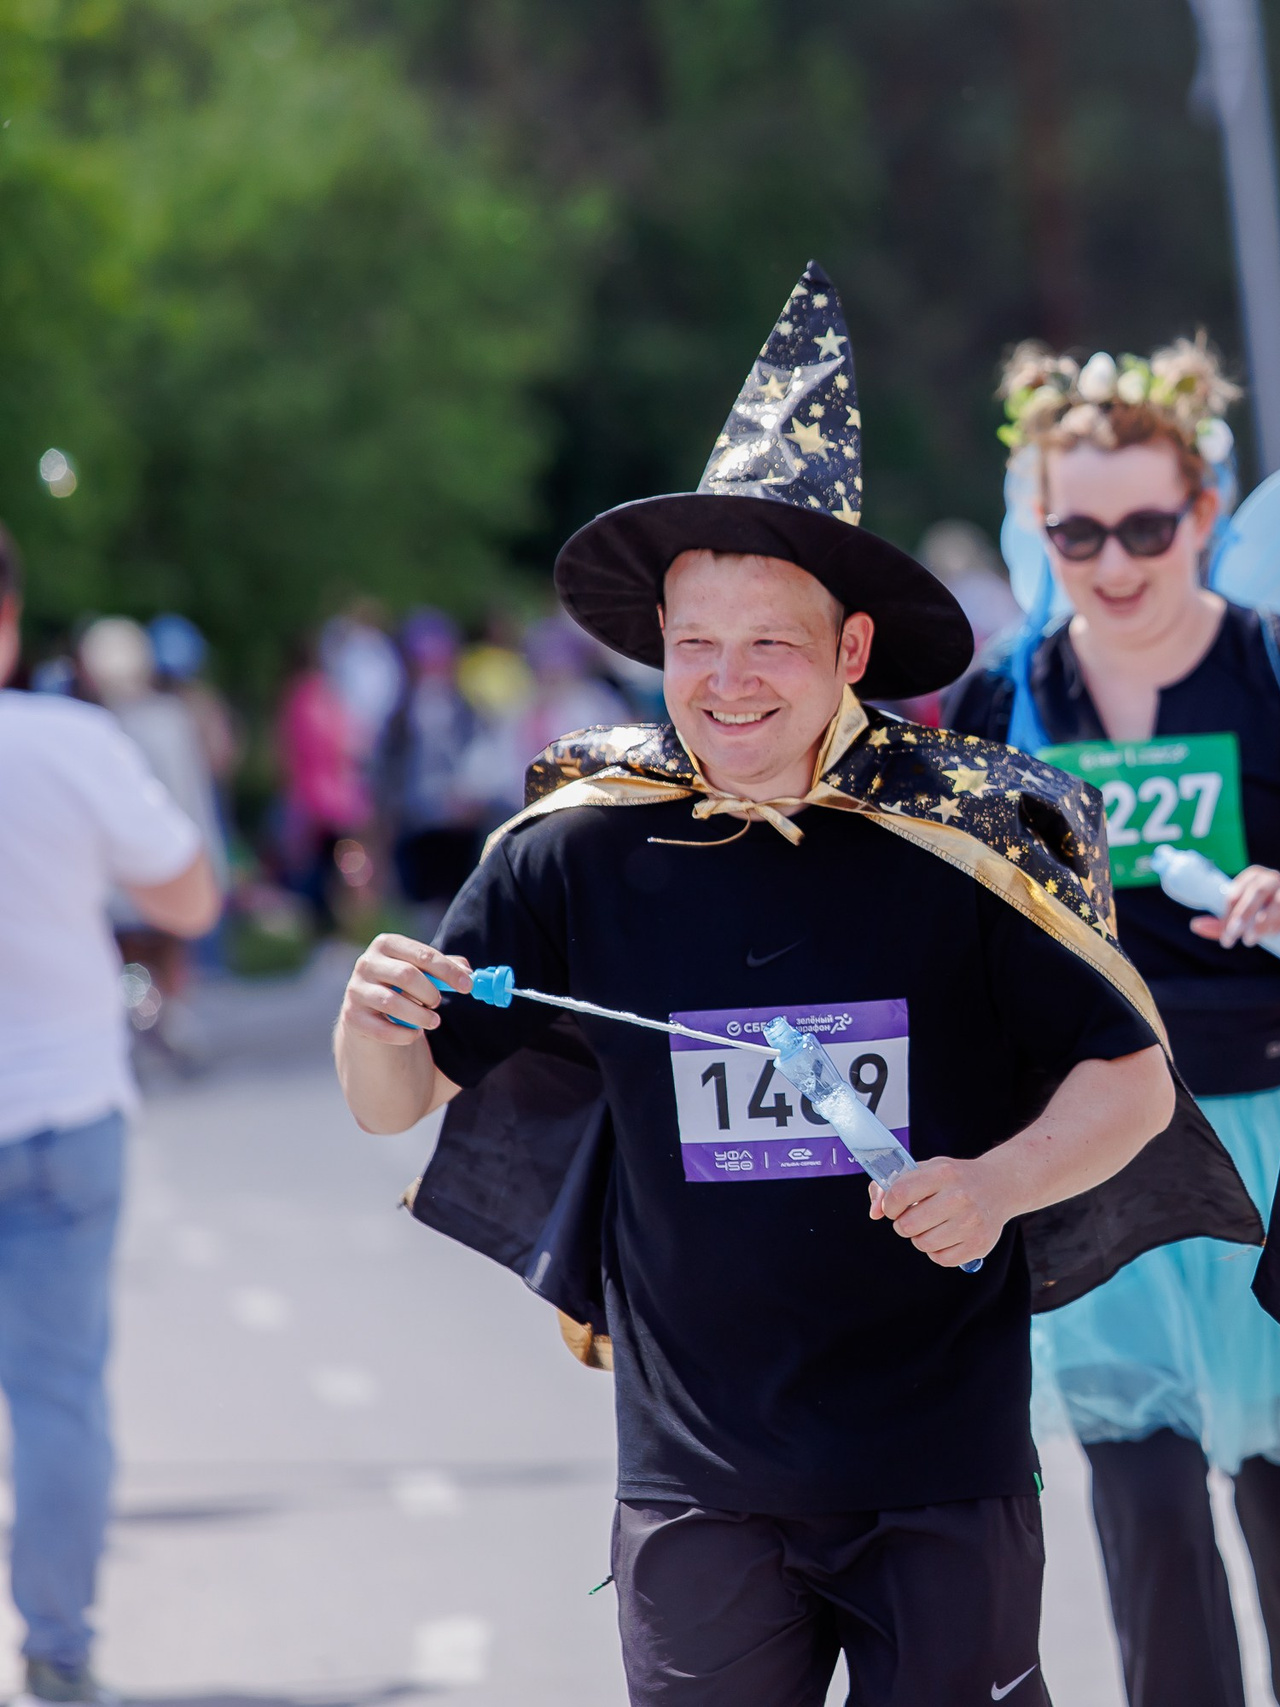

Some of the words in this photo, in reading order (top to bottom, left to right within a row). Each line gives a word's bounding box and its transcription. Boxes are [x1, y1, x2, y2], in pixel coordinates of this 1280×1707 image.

[1100, 771, 1223, 847] 227
[795, 1014, 834, 1025] зелёный
[743, 1021, 767, 1034] СБЕ
[796, 1023, 831, 1034] арафон
